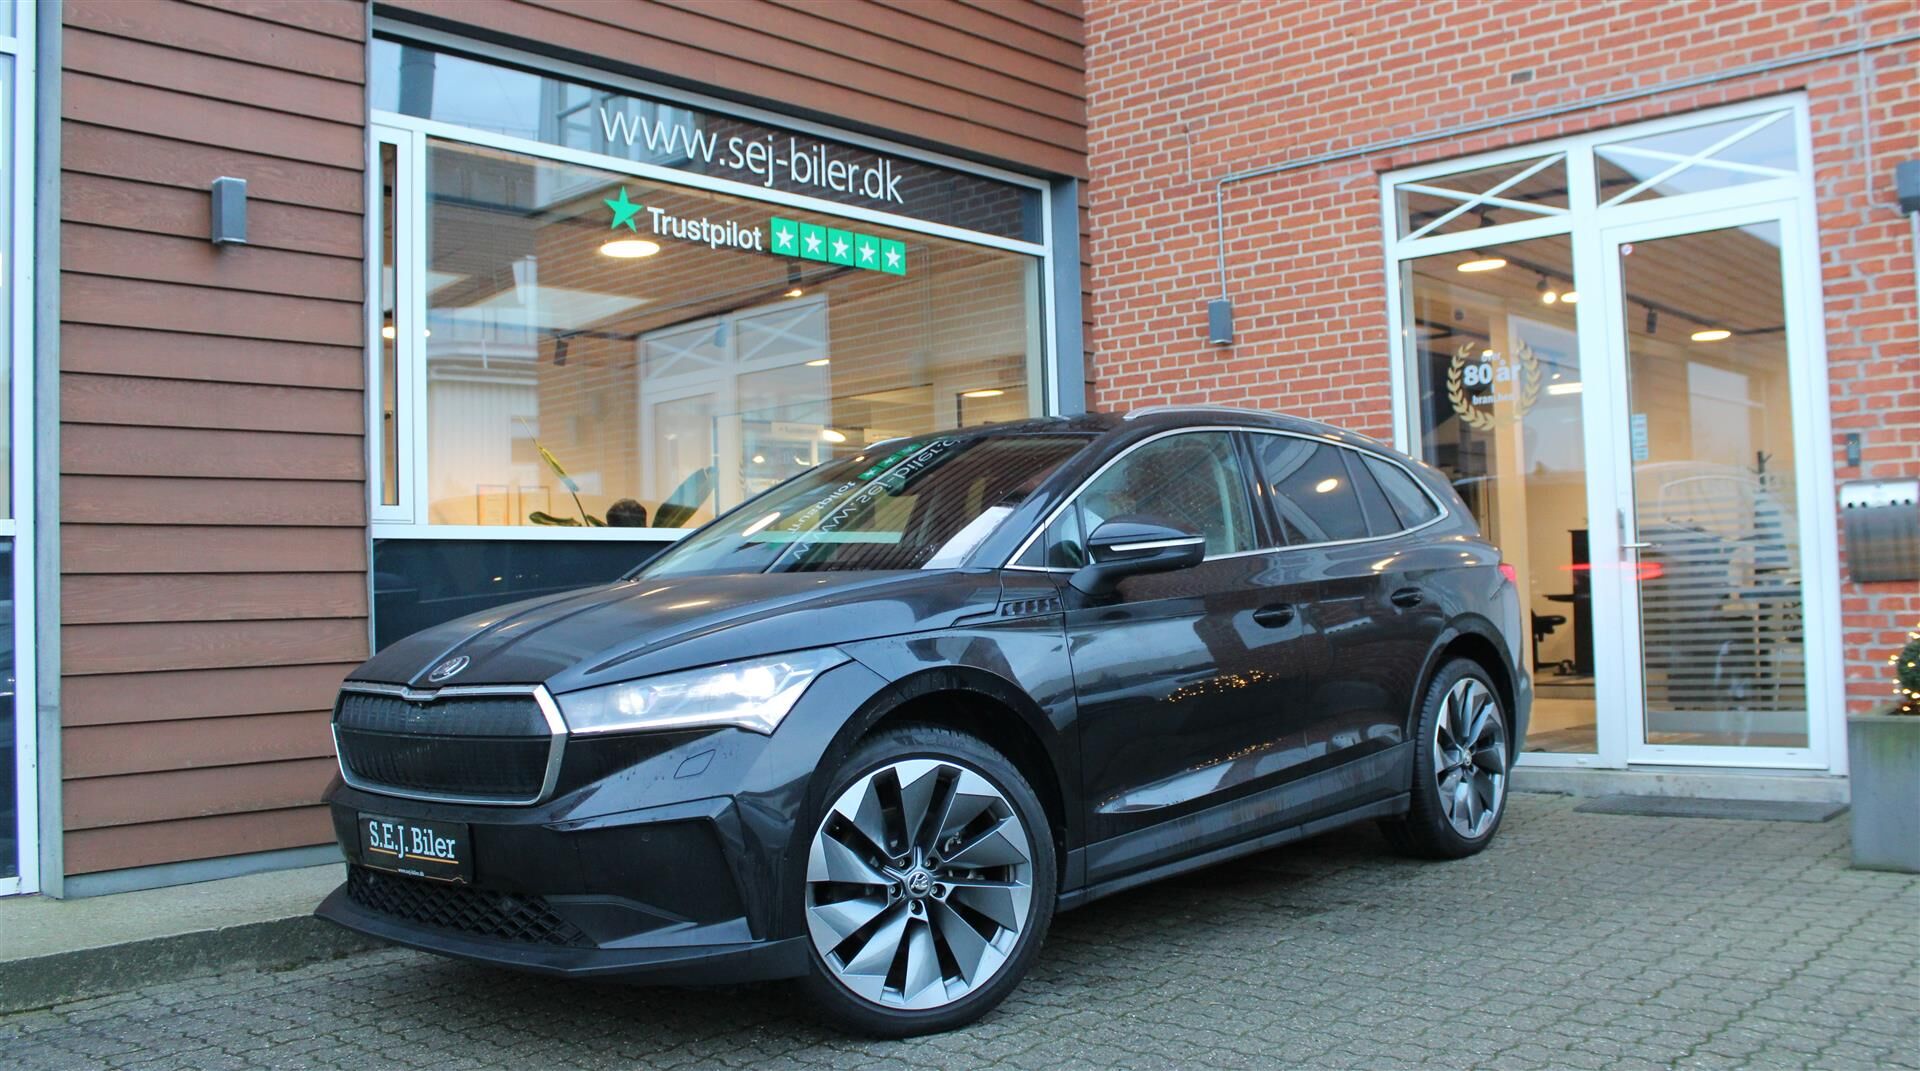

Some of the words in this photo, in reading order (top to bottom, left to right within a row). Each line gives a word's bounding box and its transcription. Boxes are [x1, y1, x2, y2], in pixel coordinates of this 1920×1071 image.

[599, 107, 905, 205] www.sej-biler.dk
[647, 206, 763, 252] Trustpilot
[1463, 364, 1492, 385] 80
[1497, 359, 1521, 382] år
[369, 821, 408, 859] S.E.J.
[411, 827, 455, 858] Biler
